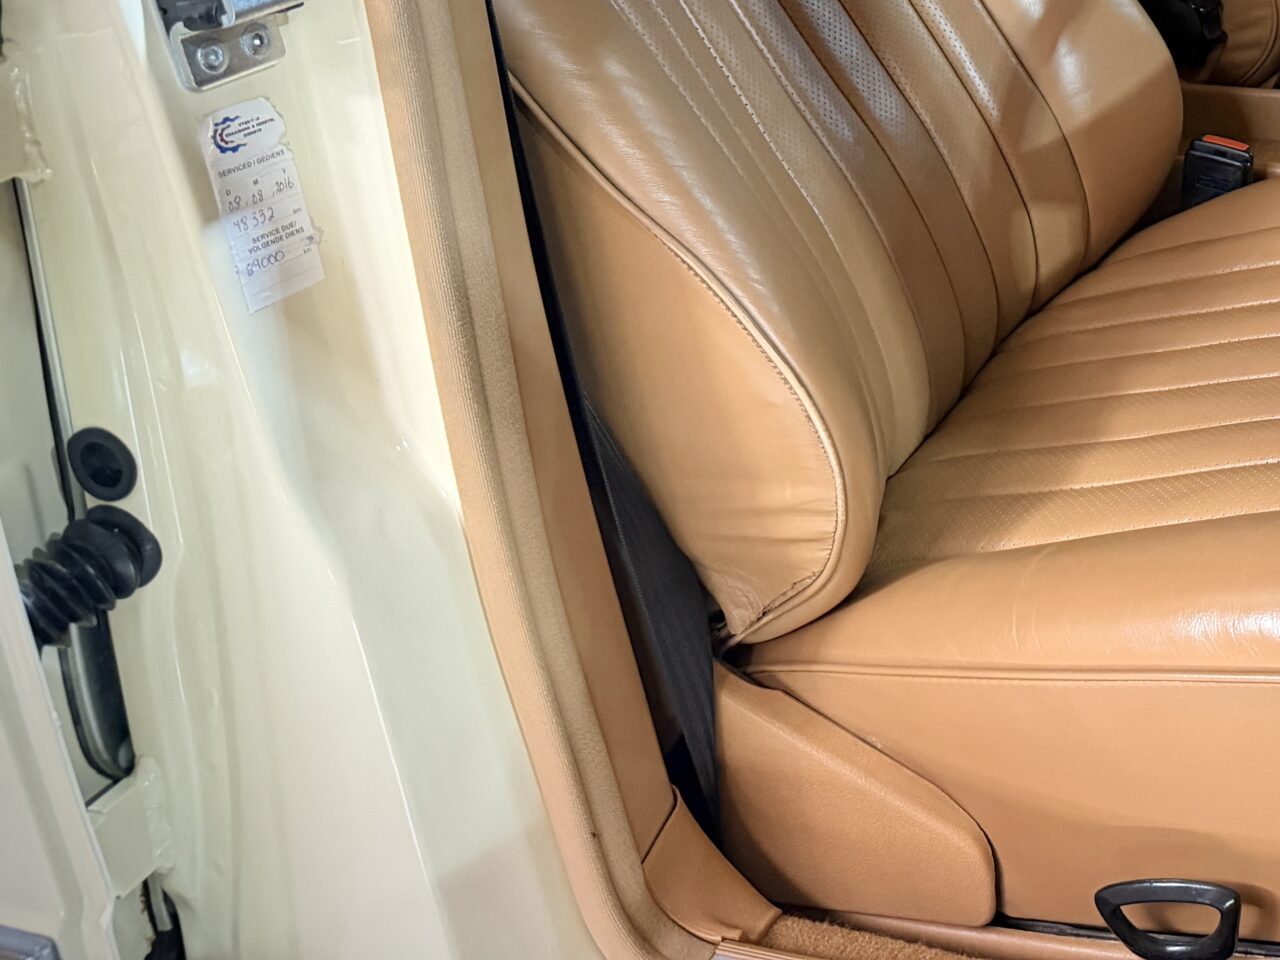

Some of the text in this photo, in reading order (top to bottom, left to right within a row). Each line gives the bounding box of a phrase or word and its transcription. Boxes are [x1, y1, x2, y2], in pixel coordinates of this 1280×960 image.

[218, 161, 252, 178] SERVICED
[256, 149, 285, 165] GEDIENS
[248, 226, 305, 254] VOLGENDE DIENS
[252, 227, 281, 244] SERVICE
